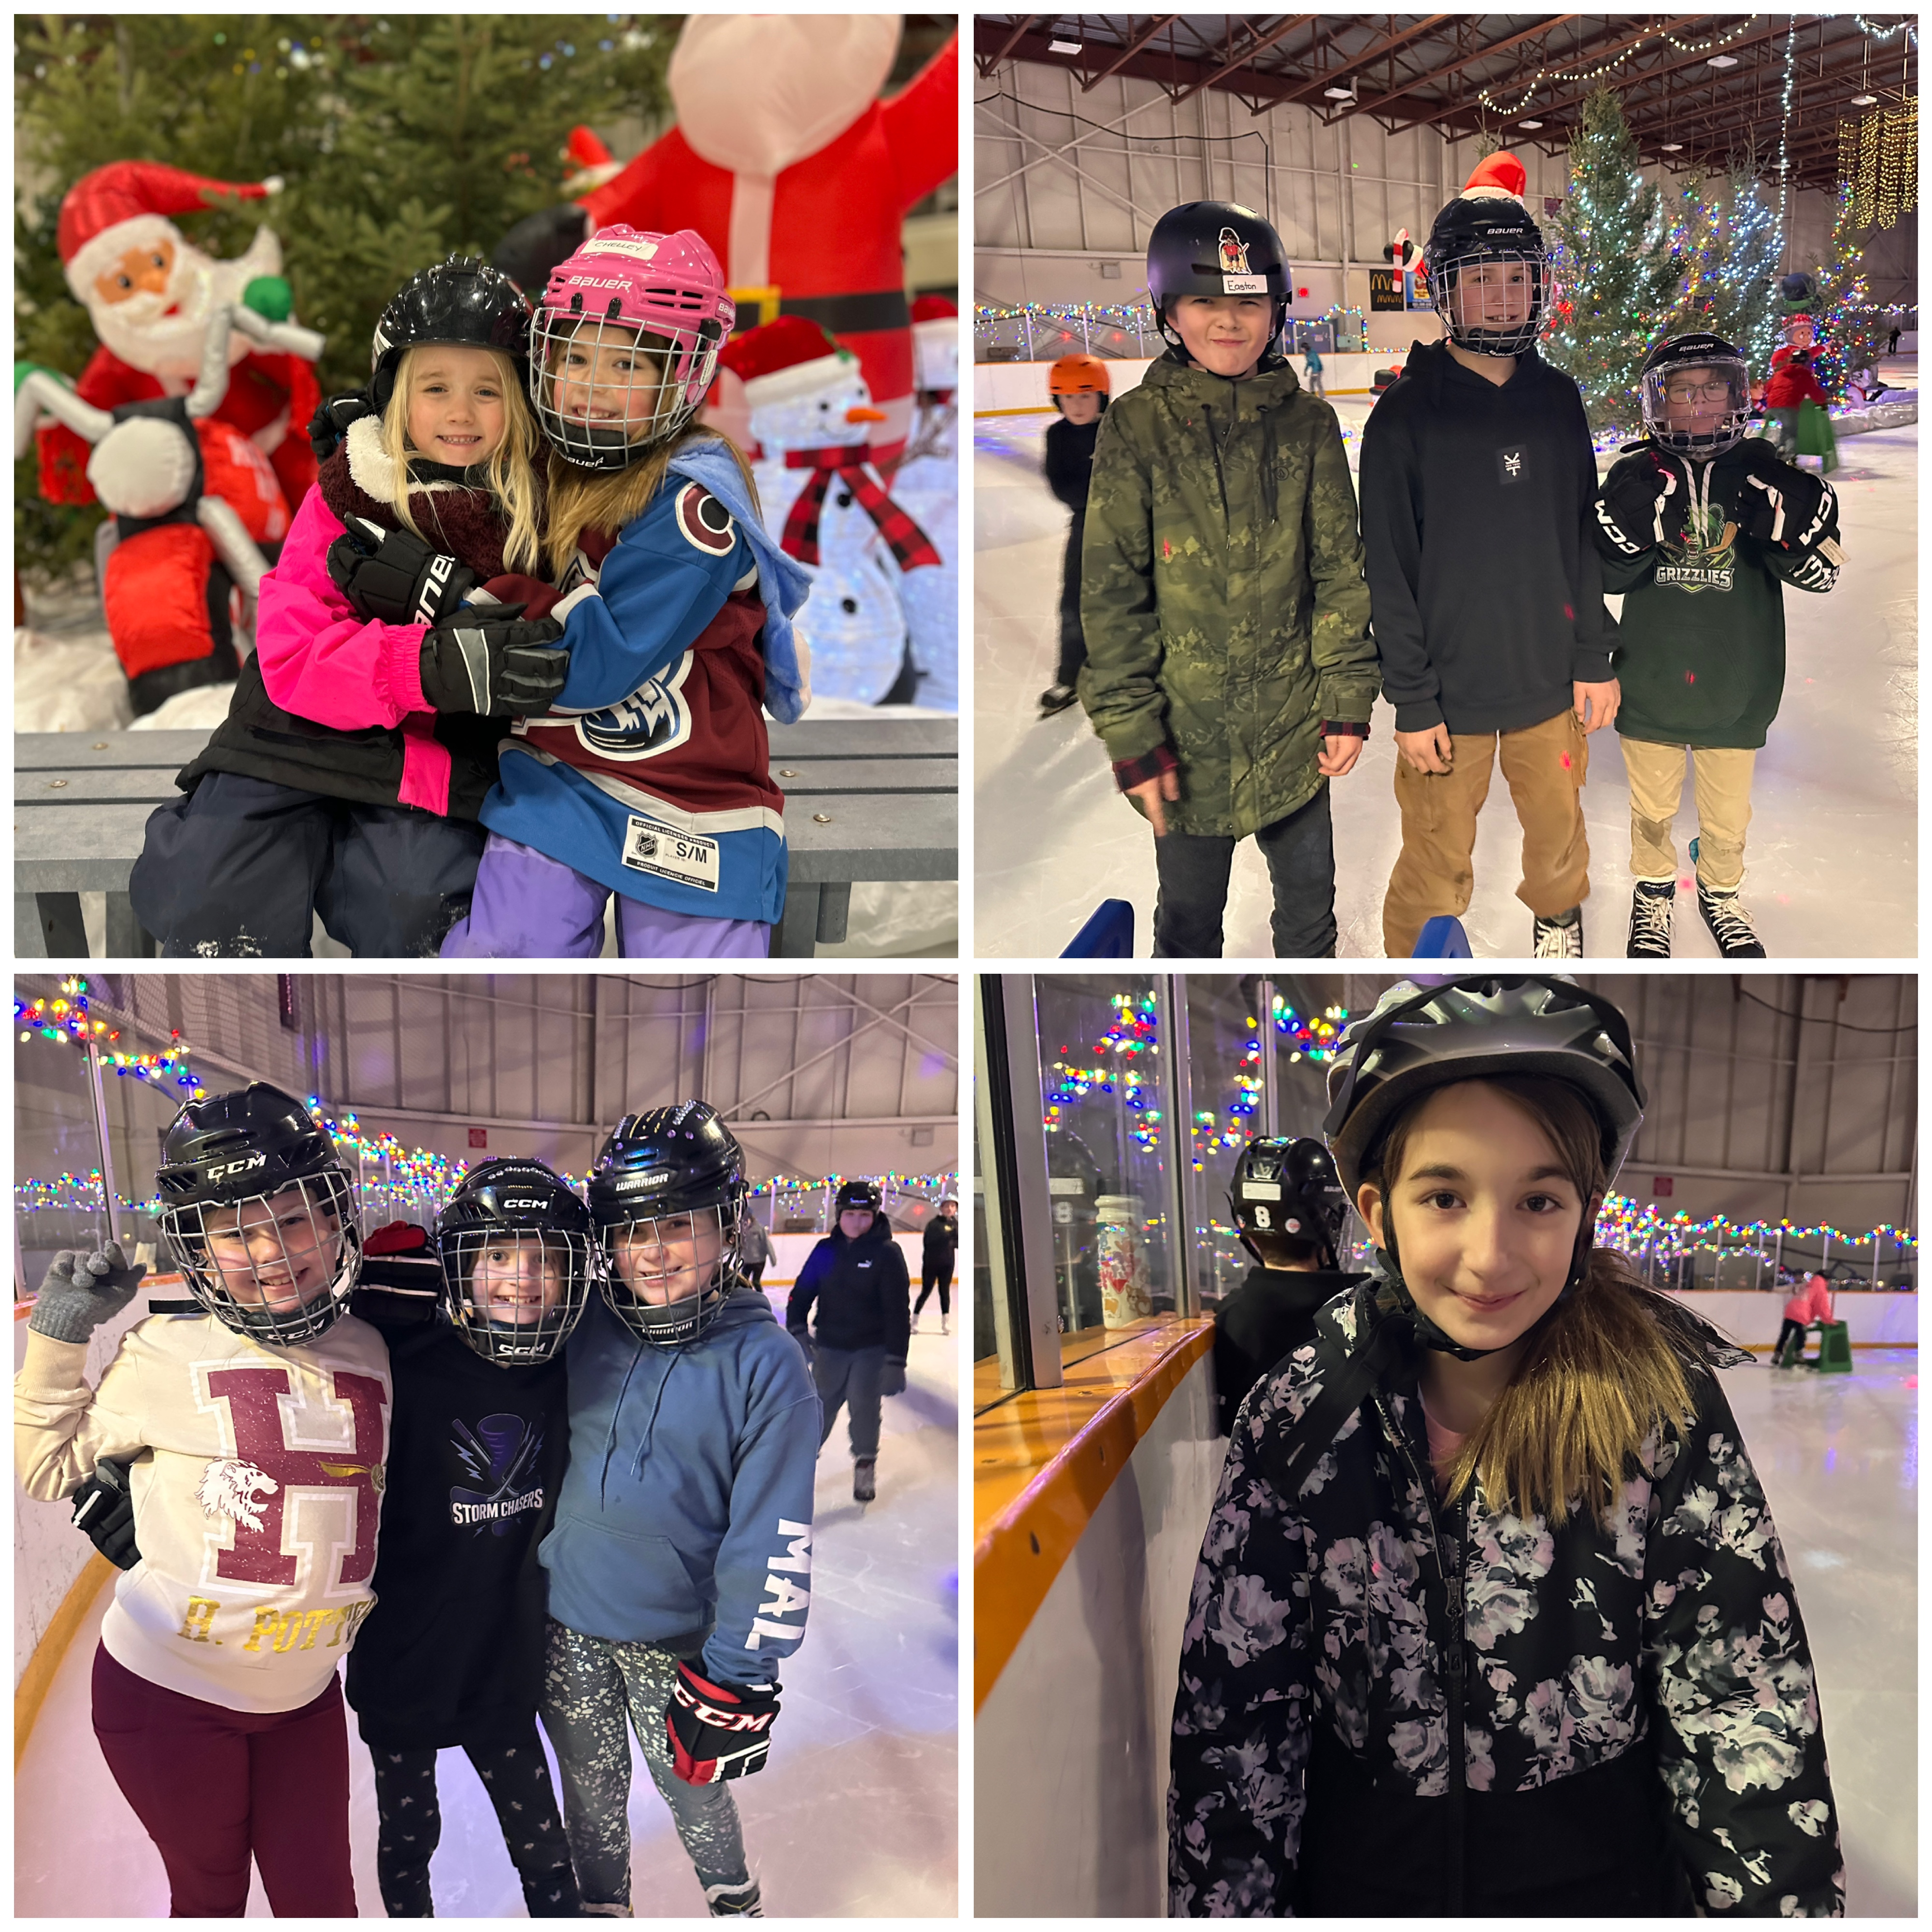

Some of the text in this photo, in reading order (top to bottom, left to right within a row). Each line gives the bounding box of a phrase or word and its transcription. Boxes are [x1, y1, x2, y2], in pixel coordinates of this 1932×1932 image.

[594, 242, 643, 252] CHELLEY
[568, 275, 632, 290] BAUER
[1227, 280, 1256, 291] Easton
[1594, 499, 1641, 554] CCM
[1656, 566, 1731, 587] GRIZZLIES
[635, 821, 713, 848] OFFICIAL LICENSED PRODUCT
[640, 841, 654, 851] NHL
[676, 842, 707, 864] S/M
[637, 861, 658, 871] PRODUIT
[684, 876, 706, 886] OFFICIEL
[206, 1154, 267, 1179] CCM
[616, 1173, 668, 1192] WARRIOR
[504, 1199, 548, 1209] CCM
[1254, 1206, 1271, 1228] 8
[267, 1318, 325, 1340] CCM
[498, 1342, 546, 1354] CCM
[453, 1488, 543, 1524] STORM CHASERS
[744, 1518, 813, 1651] MAL
[177, 1595, 223, 1645] H.
[673, 1678, 774, 1733] CCM
